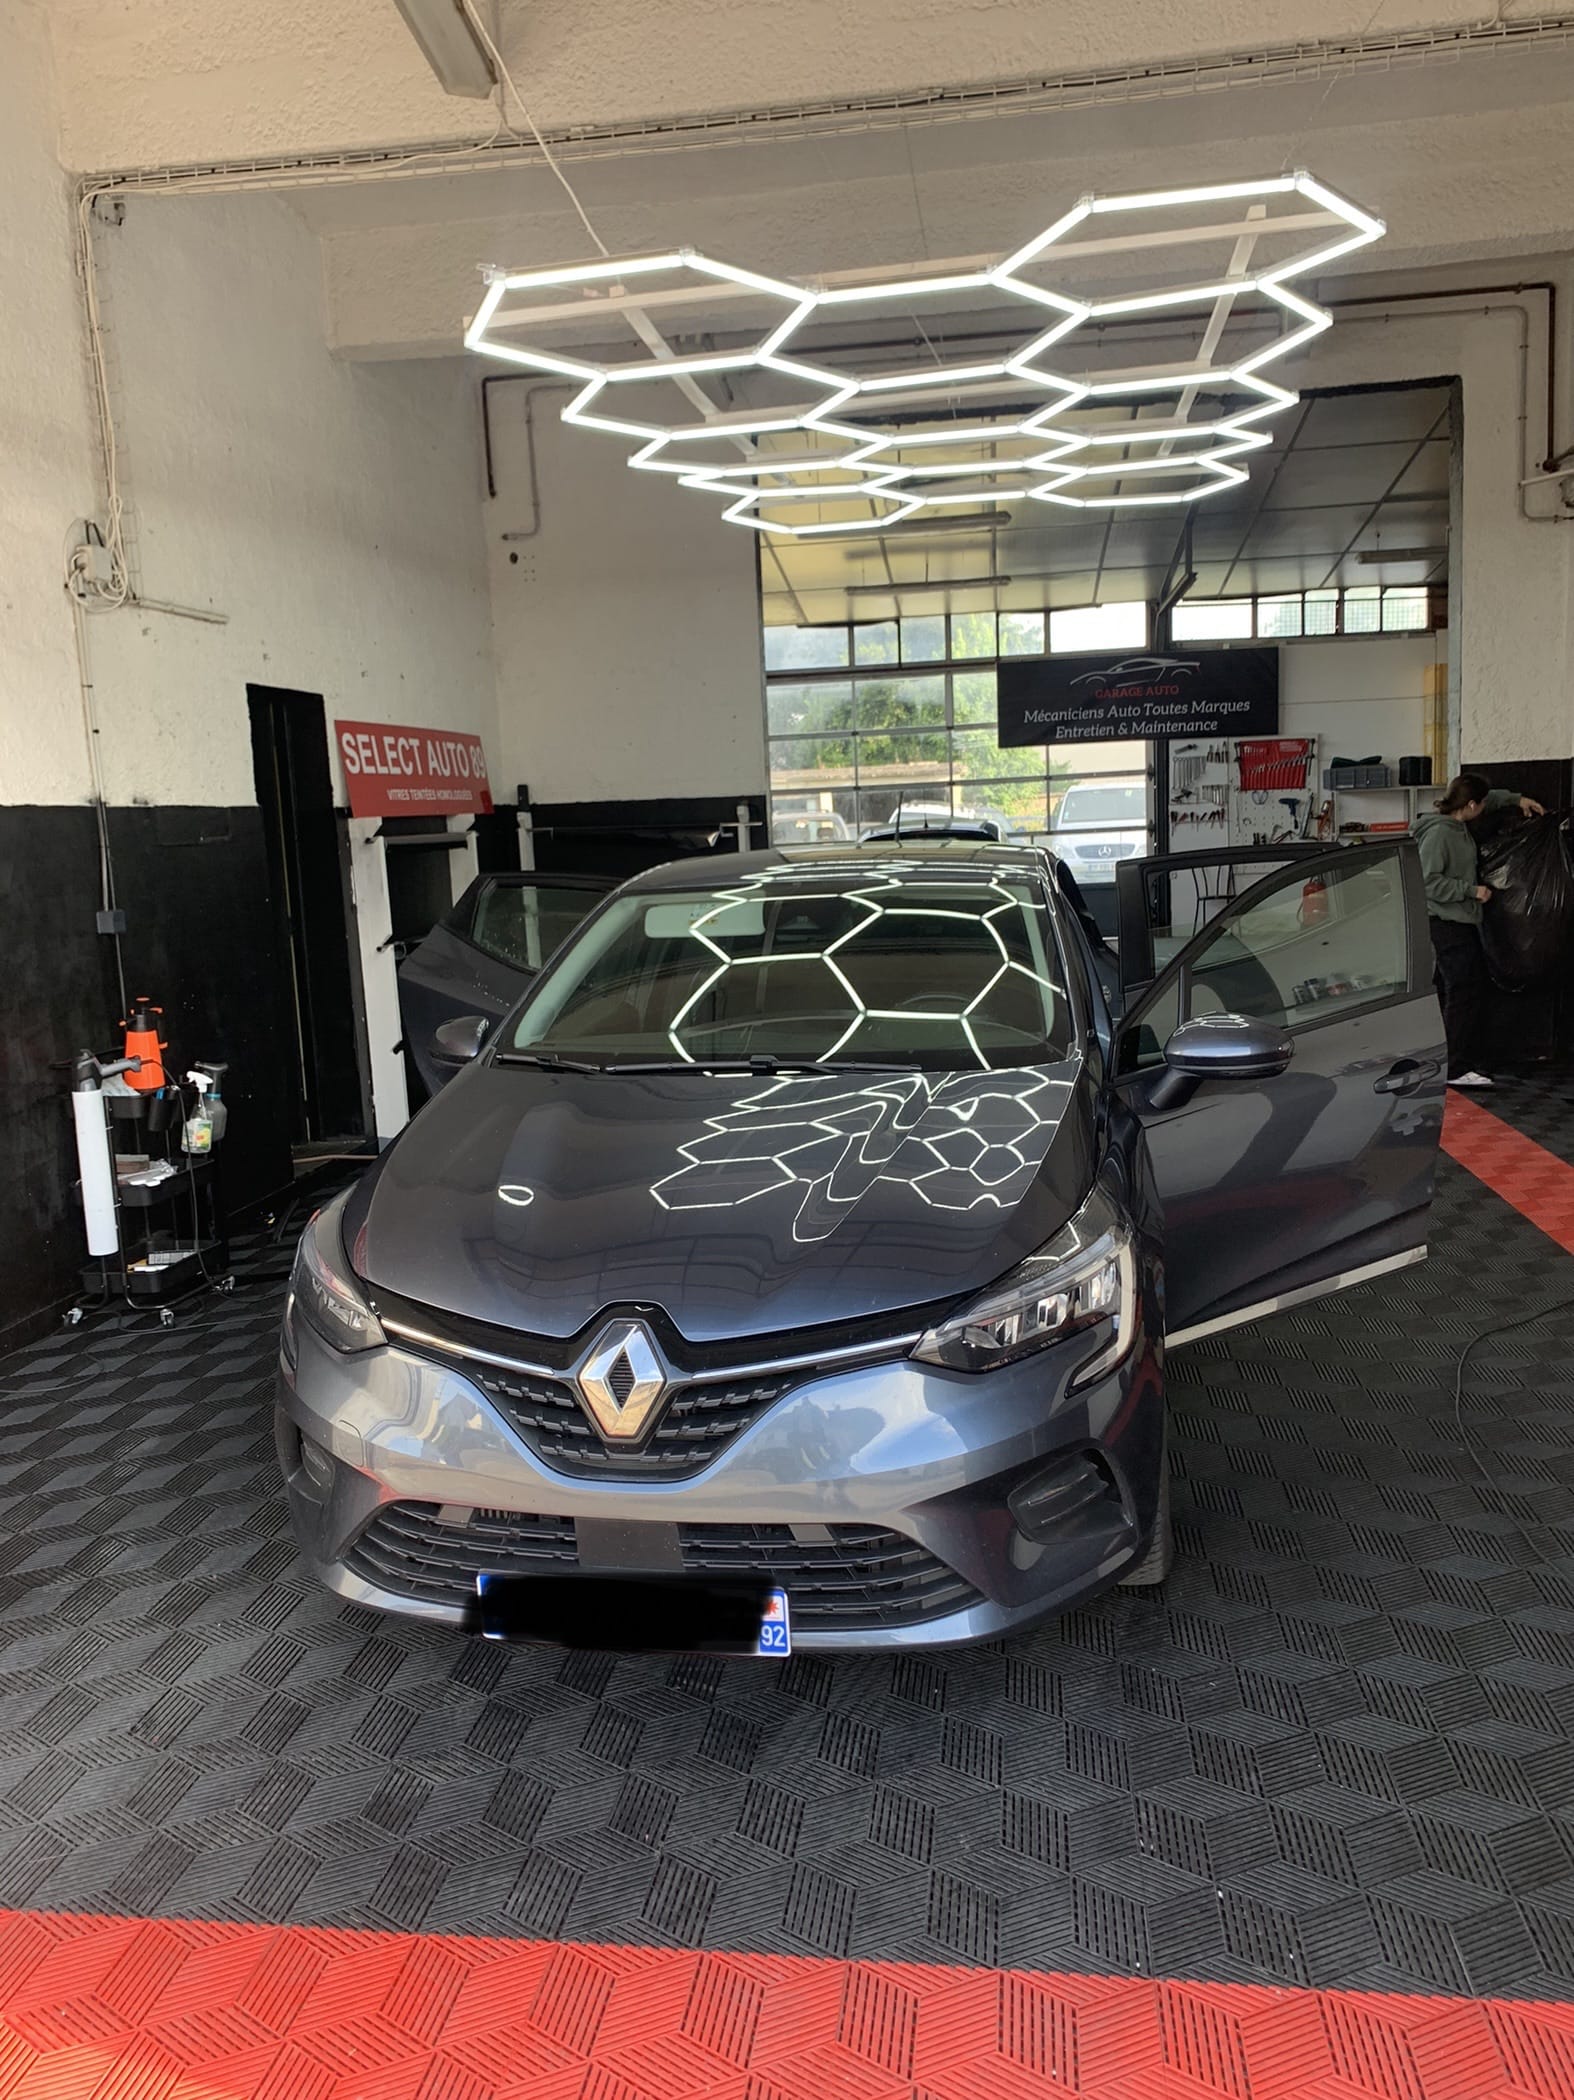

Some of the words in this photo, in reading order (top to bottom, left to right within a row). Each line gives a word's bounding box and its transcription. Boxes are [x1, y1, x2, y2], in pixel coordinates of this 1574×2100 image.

[1094, 687, 1143, 699] GARAGE
[1147, 685, 1180, 696] AUTO
[1023, 709, 1105, 724] Mécaniciens
[1107, 705, 1142, 718] Auto
[1144, 702, 1188, 716] Toutes
[1191, 699, 1251, 716] Marques
[1055, 724, 1115, 739] Entretien
[1117, 722, 1129, 735] &
[1131, 719, 1218, 735] Maintenance
[342, 732, 423, 775] SELECT
[427, 740, 470, 777] AUTO
[470, 744, 487, 779] 89
[761, 1625, 786, 1647] 92
